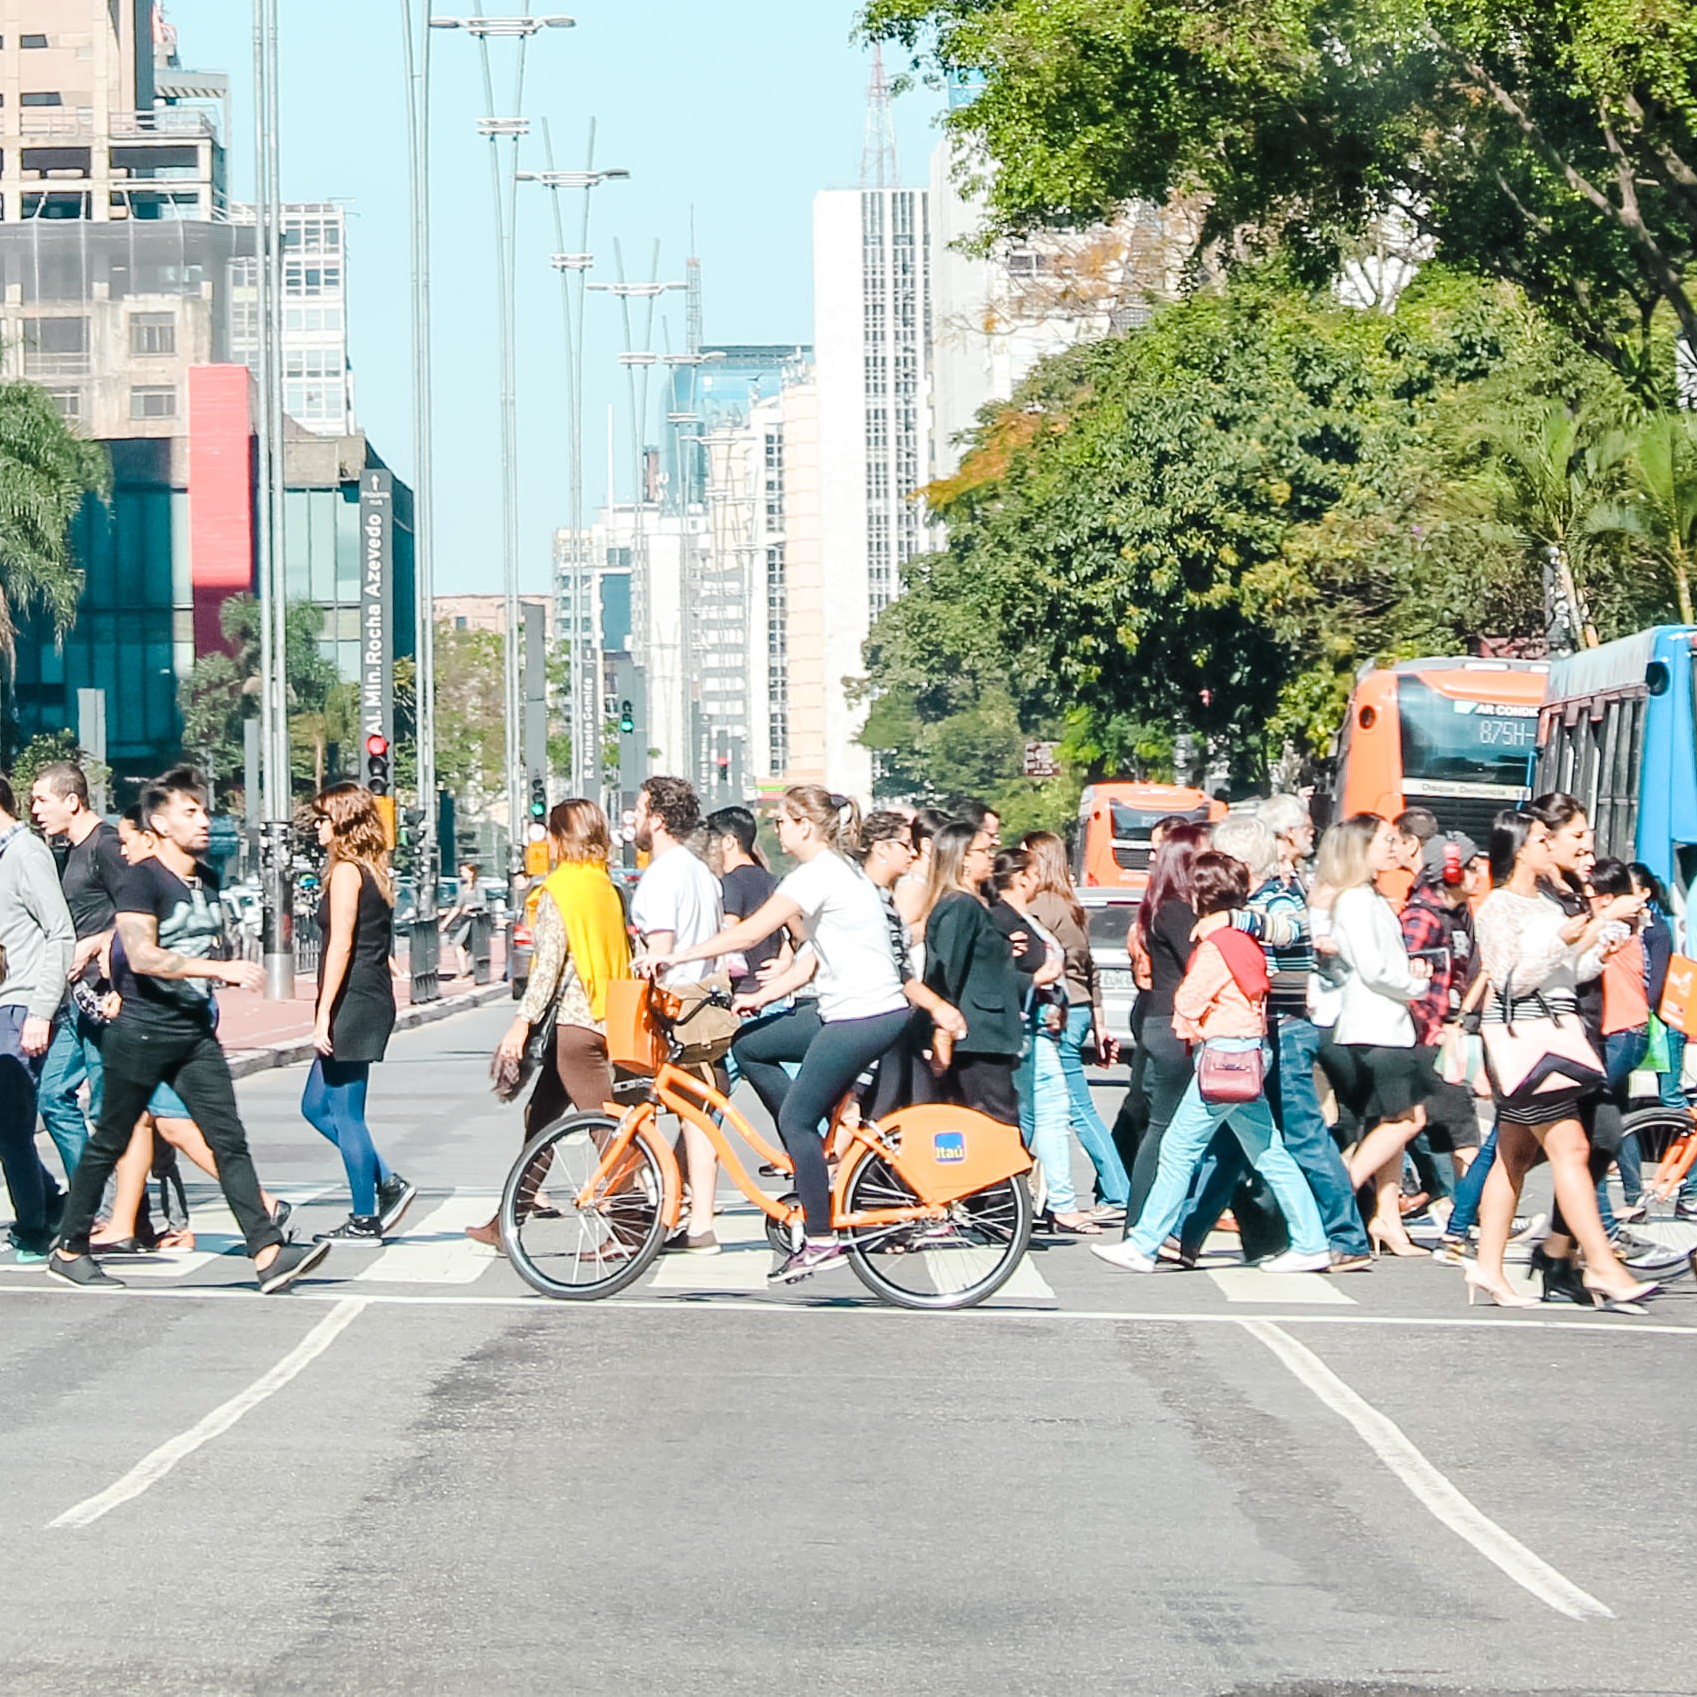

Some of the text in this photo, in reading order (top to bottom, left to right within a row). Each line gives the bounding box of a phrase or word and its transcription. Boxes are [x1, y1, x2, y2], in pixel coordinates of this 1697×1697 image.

[363, 513, 383, 598] Azevedo
[1475, 704, 1495, 715] AR
[583, 723, 595, 766] Peixoto
[935, 1144, 964, 1160] Itaú
